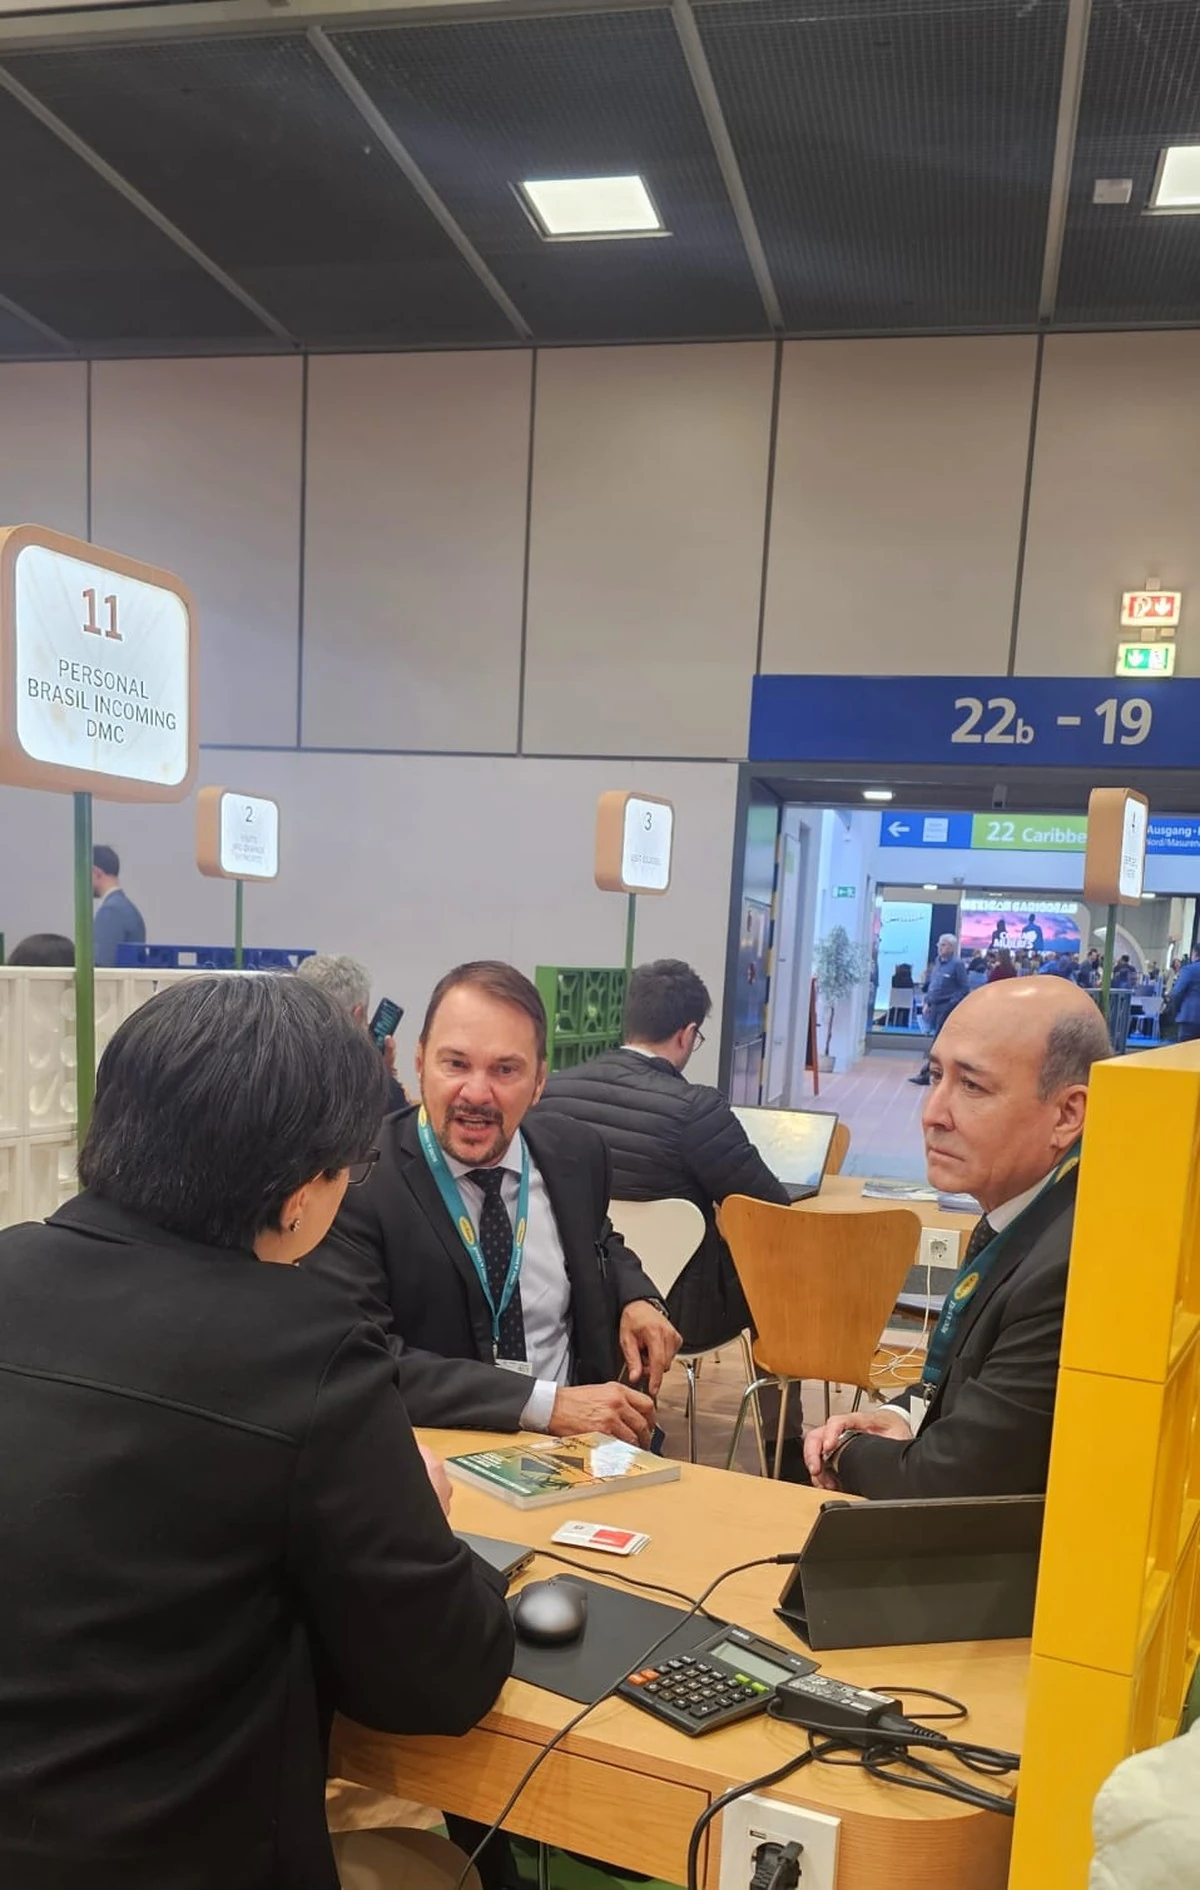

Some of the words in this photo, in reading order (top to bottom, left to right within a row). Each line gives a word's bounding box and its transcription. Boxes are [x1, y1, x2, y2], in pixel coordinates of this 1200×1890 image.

[82, 588, 123, 641] 11
[59, 659, 149, 700] PERSONAL
[28, 678, 90, 710] BRASIL
[95, 695, 177, 730] INCOMING
[87, 719, 124, 744] DMC
[951, 697, 1035, 744] 22b
[1094, 698, 1153, 745] 19
[245, 805, 253, 823] 2
[644, 811, 653, 831] 3
[986, 821, 1015, 842] 22
